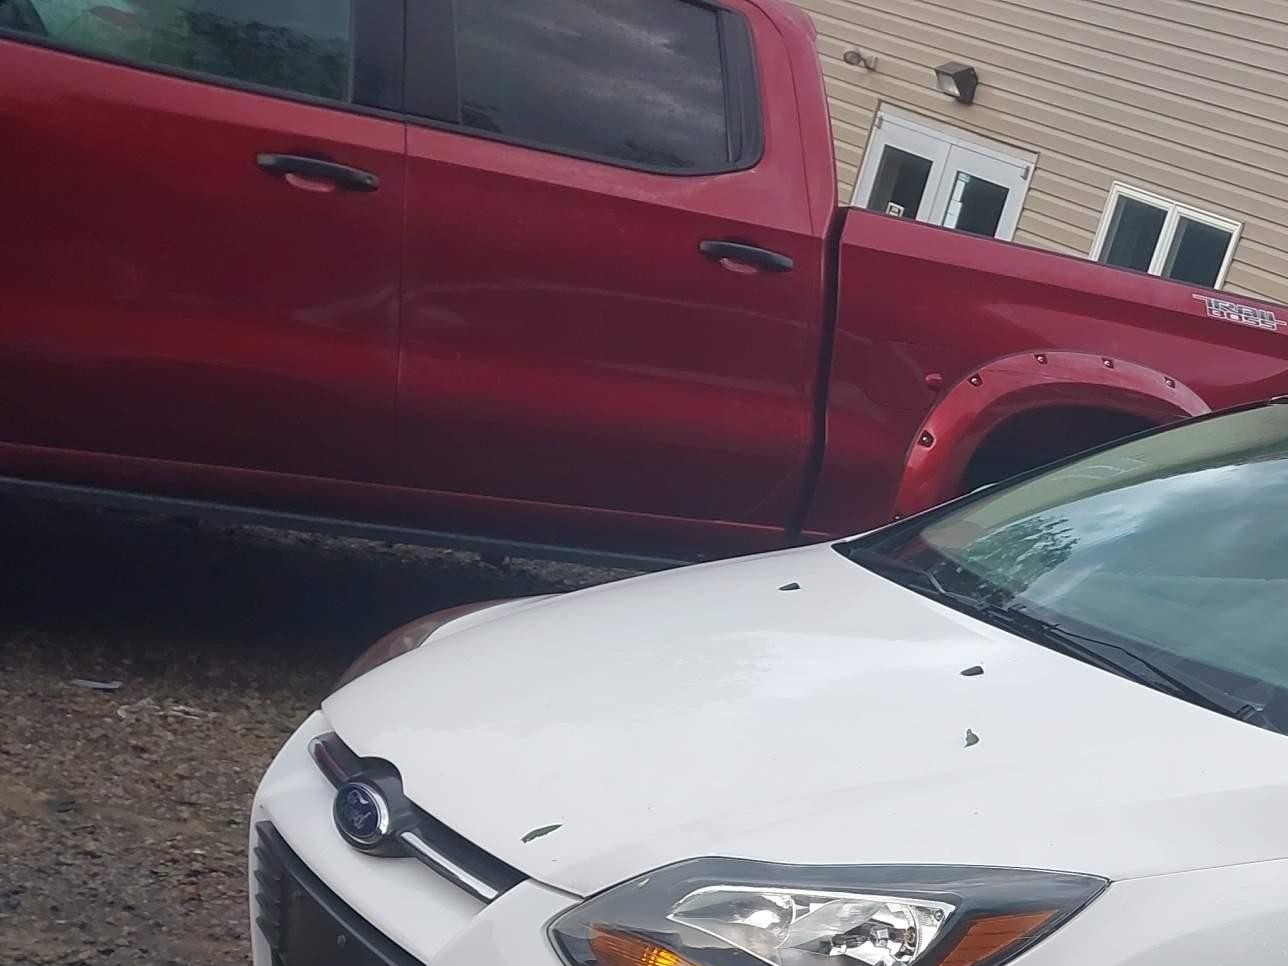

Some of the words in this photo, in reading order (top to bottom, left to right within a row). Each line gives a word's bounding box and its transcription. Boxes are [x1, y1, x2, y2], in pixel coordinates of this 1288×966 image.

[1192, 294, 1288, 326] TRAIL
[1206, 306, 1278, 331] BOSS
[346, 789, 372, 830] Fd
